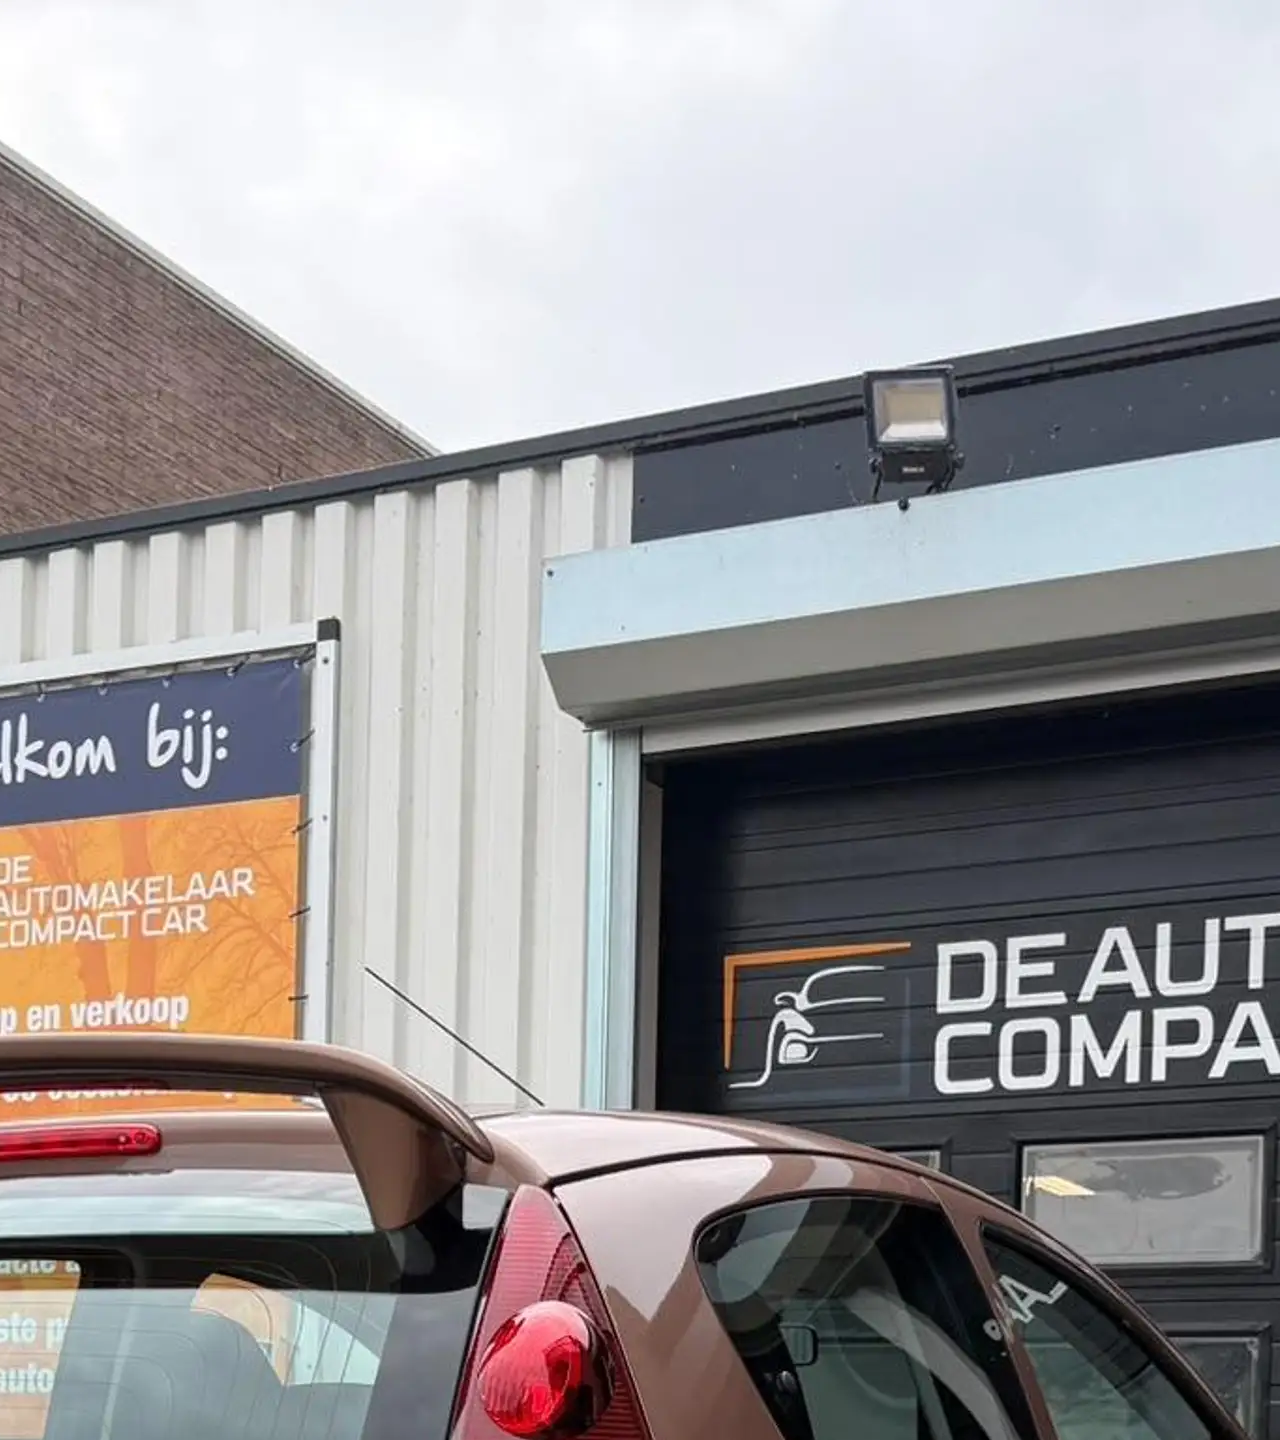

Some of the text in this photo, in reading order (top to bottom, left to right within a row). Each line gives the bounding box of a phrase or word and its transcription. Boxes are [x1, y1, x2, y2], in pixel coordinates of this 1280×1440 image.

[147, 702, 229, 789] bij:
[141, 903, 209, 937] CAR
[936, 931, 1067, 1014] DE
[27, 1003, 61, 1032] en
[70, 993, 190, 1033] verkoop
